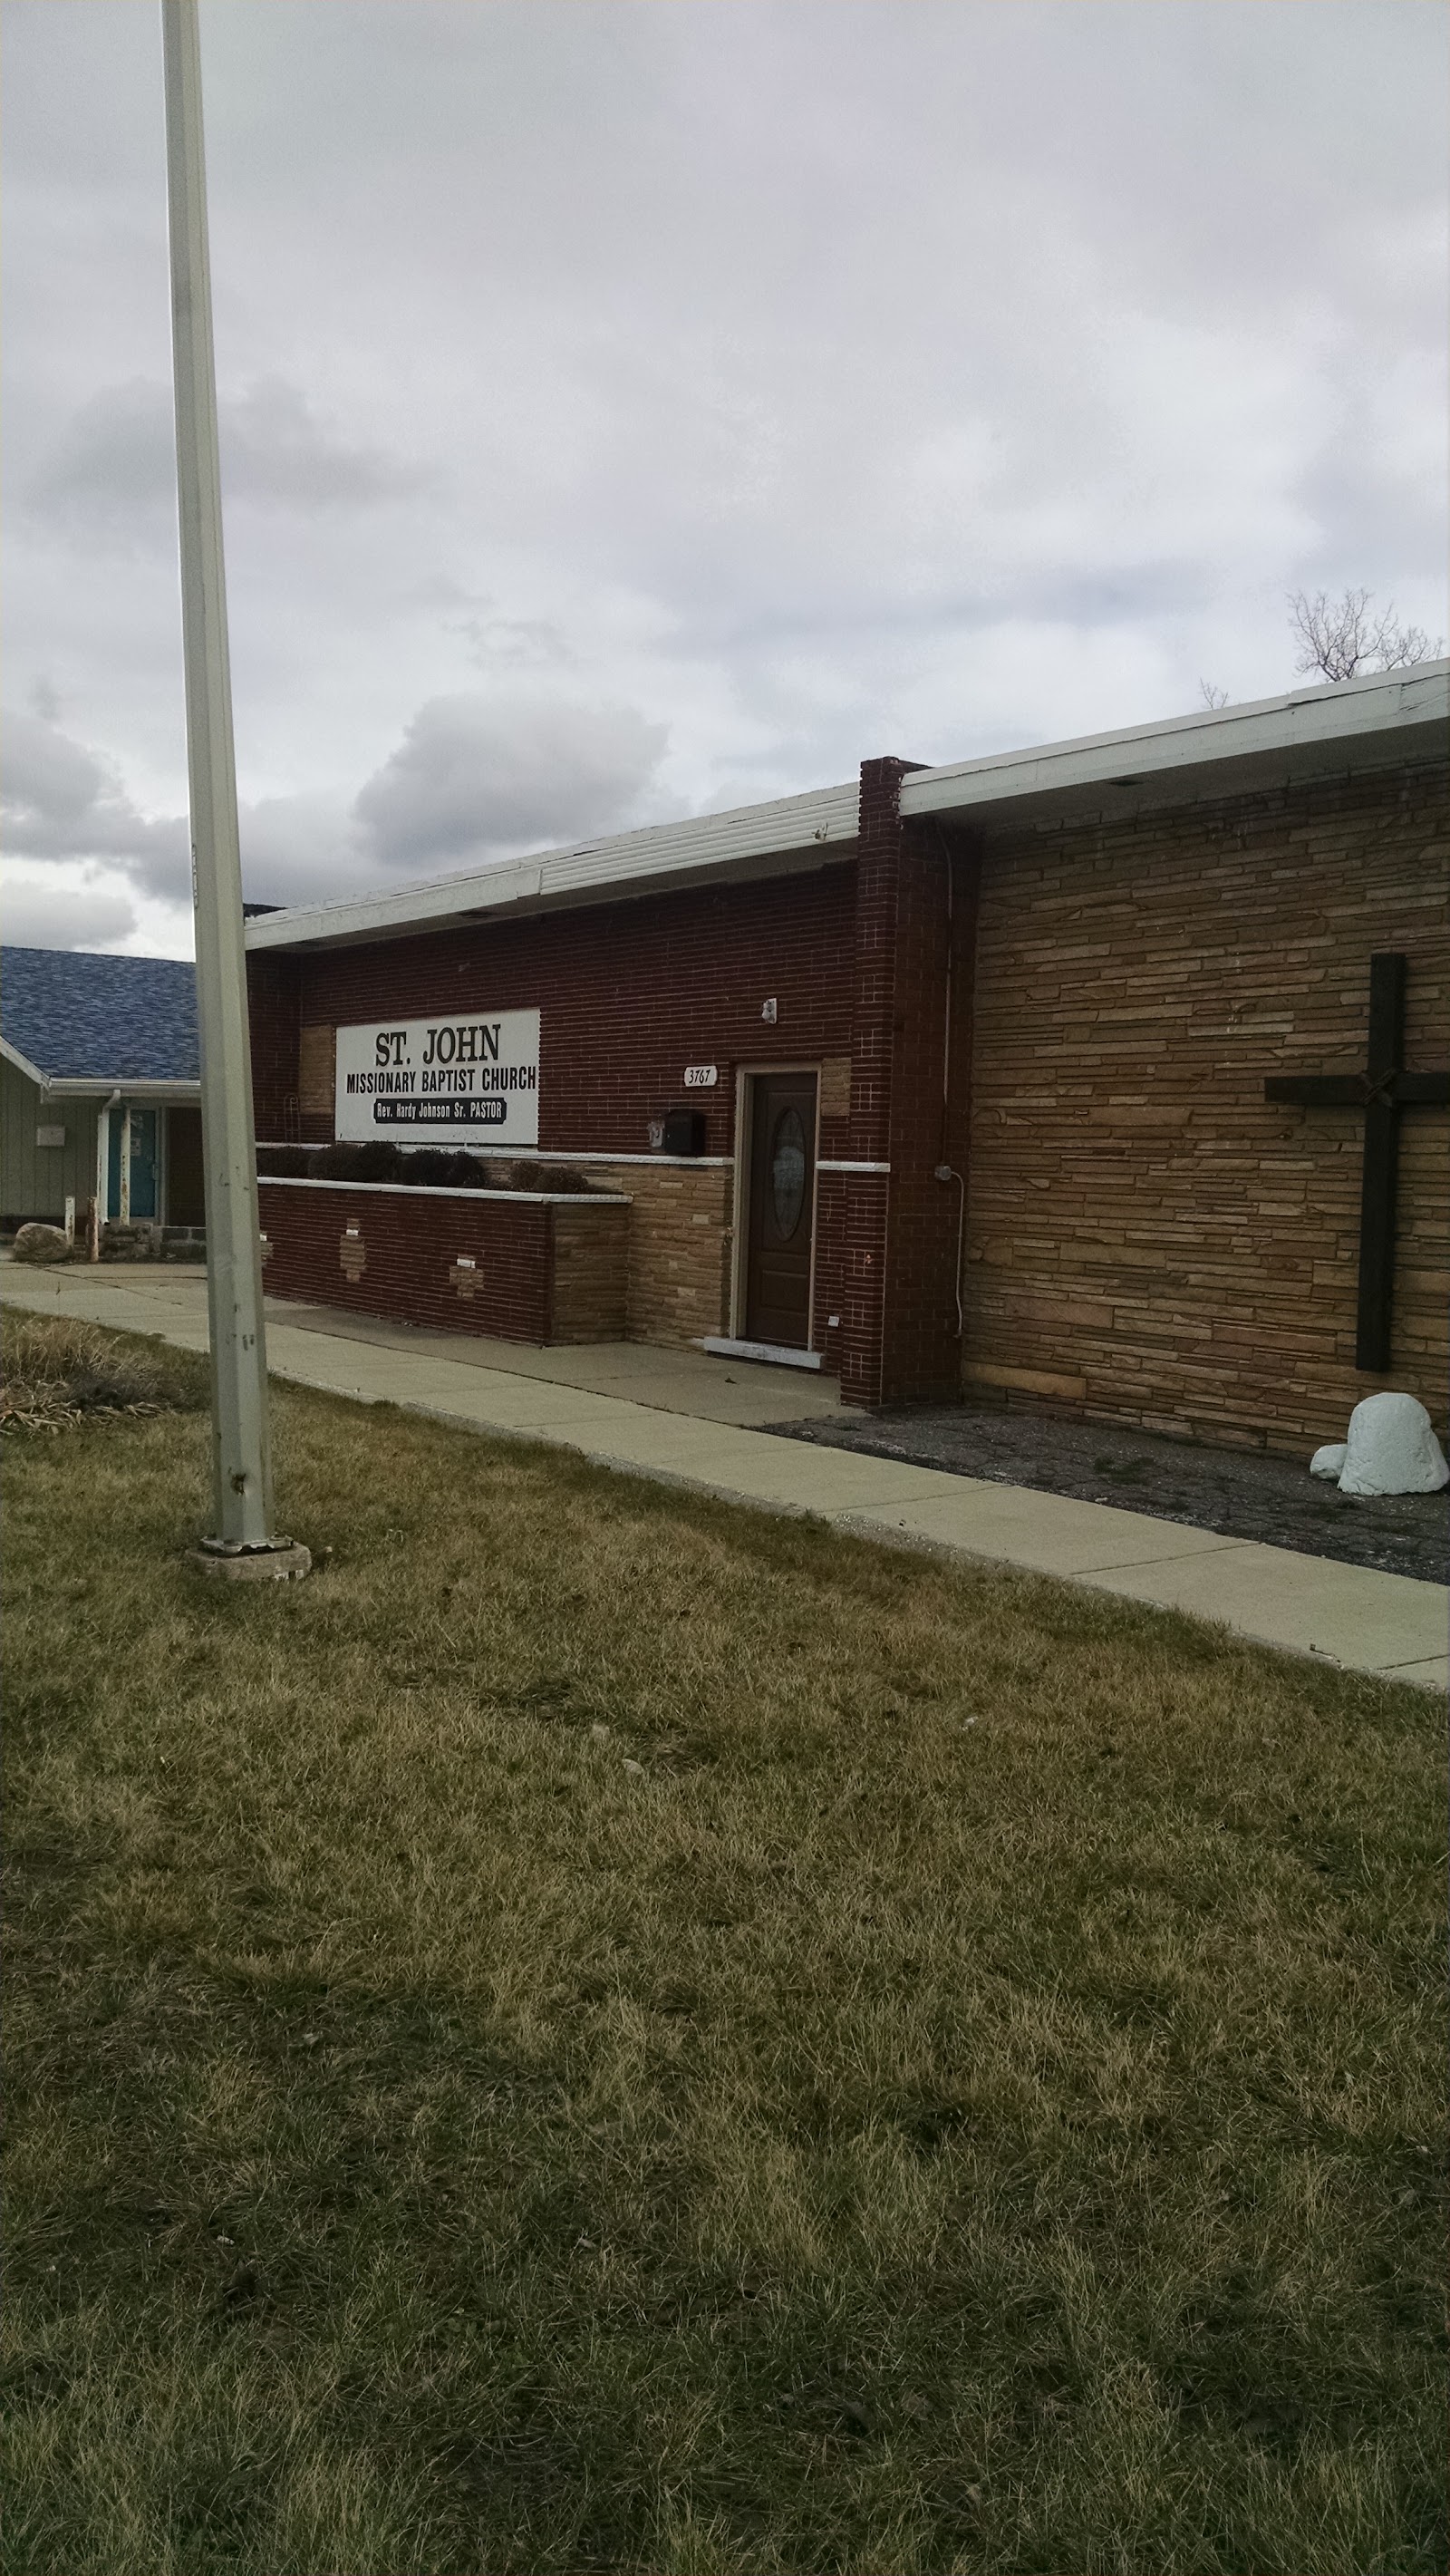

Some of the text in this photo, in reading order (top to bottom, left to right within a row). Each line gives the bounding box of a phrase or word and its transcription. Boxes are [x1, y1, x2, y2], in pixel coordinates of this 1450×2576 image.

[375, 1024, 501, 1066] ST. JOHN
[346, 1066, 536, 1094] MISSIONARY BAPTIST CHURCH
[689, 1069, 711, 1083] 3767
[377, 1101, 502, 1120] Rev. Hardy Johnson Sr. PASTOR
